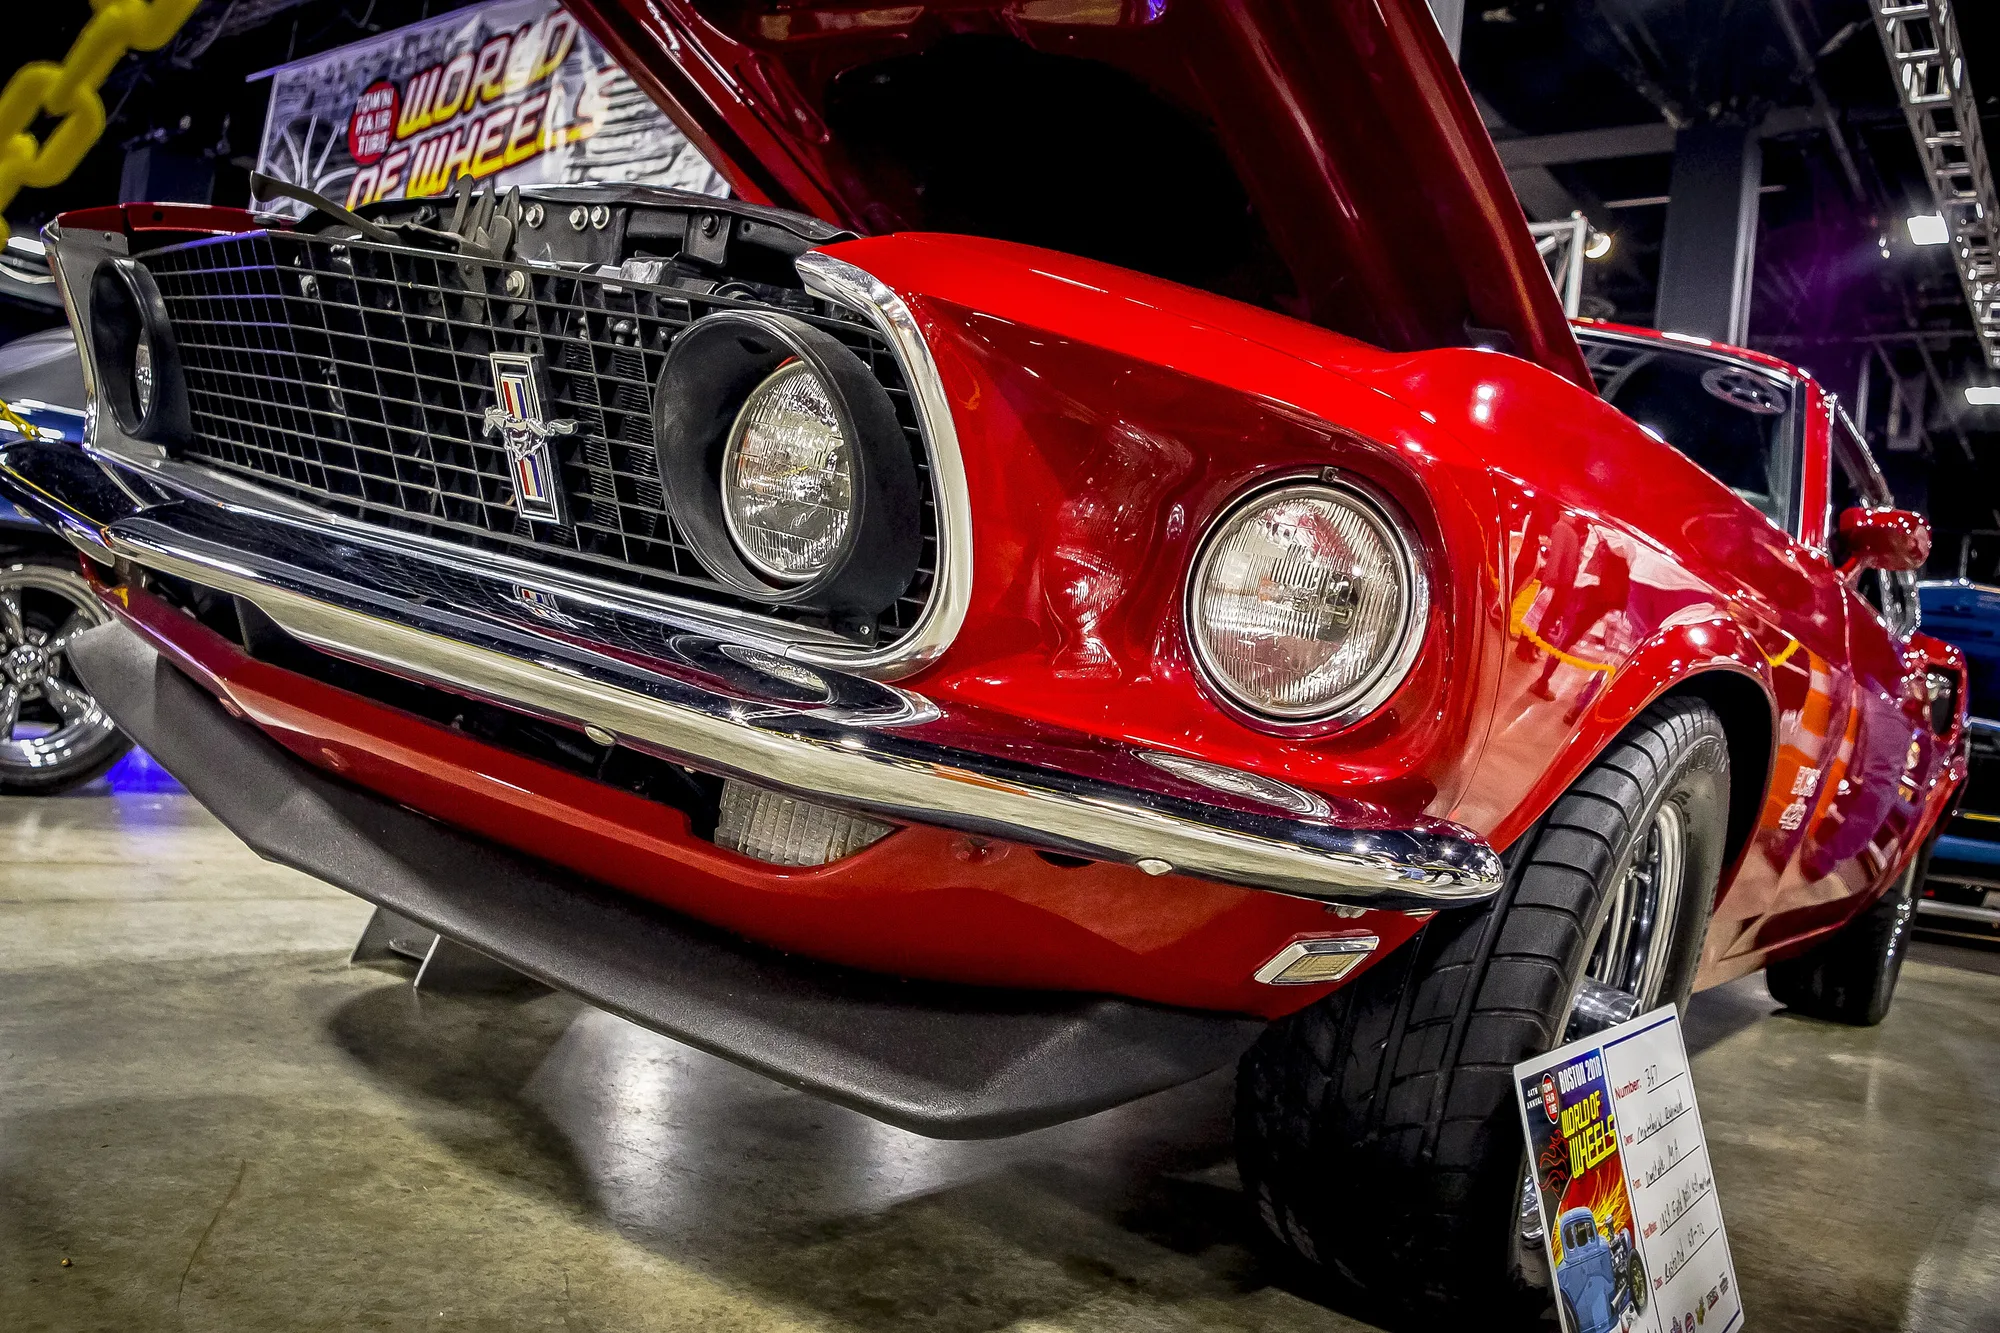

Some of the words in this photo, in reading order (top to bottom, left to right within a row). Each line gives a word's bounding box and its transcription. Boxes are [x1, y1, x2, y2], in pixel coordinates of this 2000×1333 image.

[396, 9, 579, 139] WORLD
[356, 87, 394, 115] TOWN
[356, 109, 392, 136] FAIR
[346, 150, 408, 212] OF
[405, 66, 617, 199] WHEELS
[358, 130, 389, 156] TIRE
[1558, 1061, 1585, 1094] BOSTON
[1614, 1078, 1642, 1101] Number:
[1527, 1086, 1538, 1098] 44TH
[1527, 1096, 1543, 1110] ANNUAL
[1561, 1098, 1590, 1139] WORLD
[1590, 1090, 1601, 1120] OF
[1569, 1114, 1617, 1179] WHEELS
